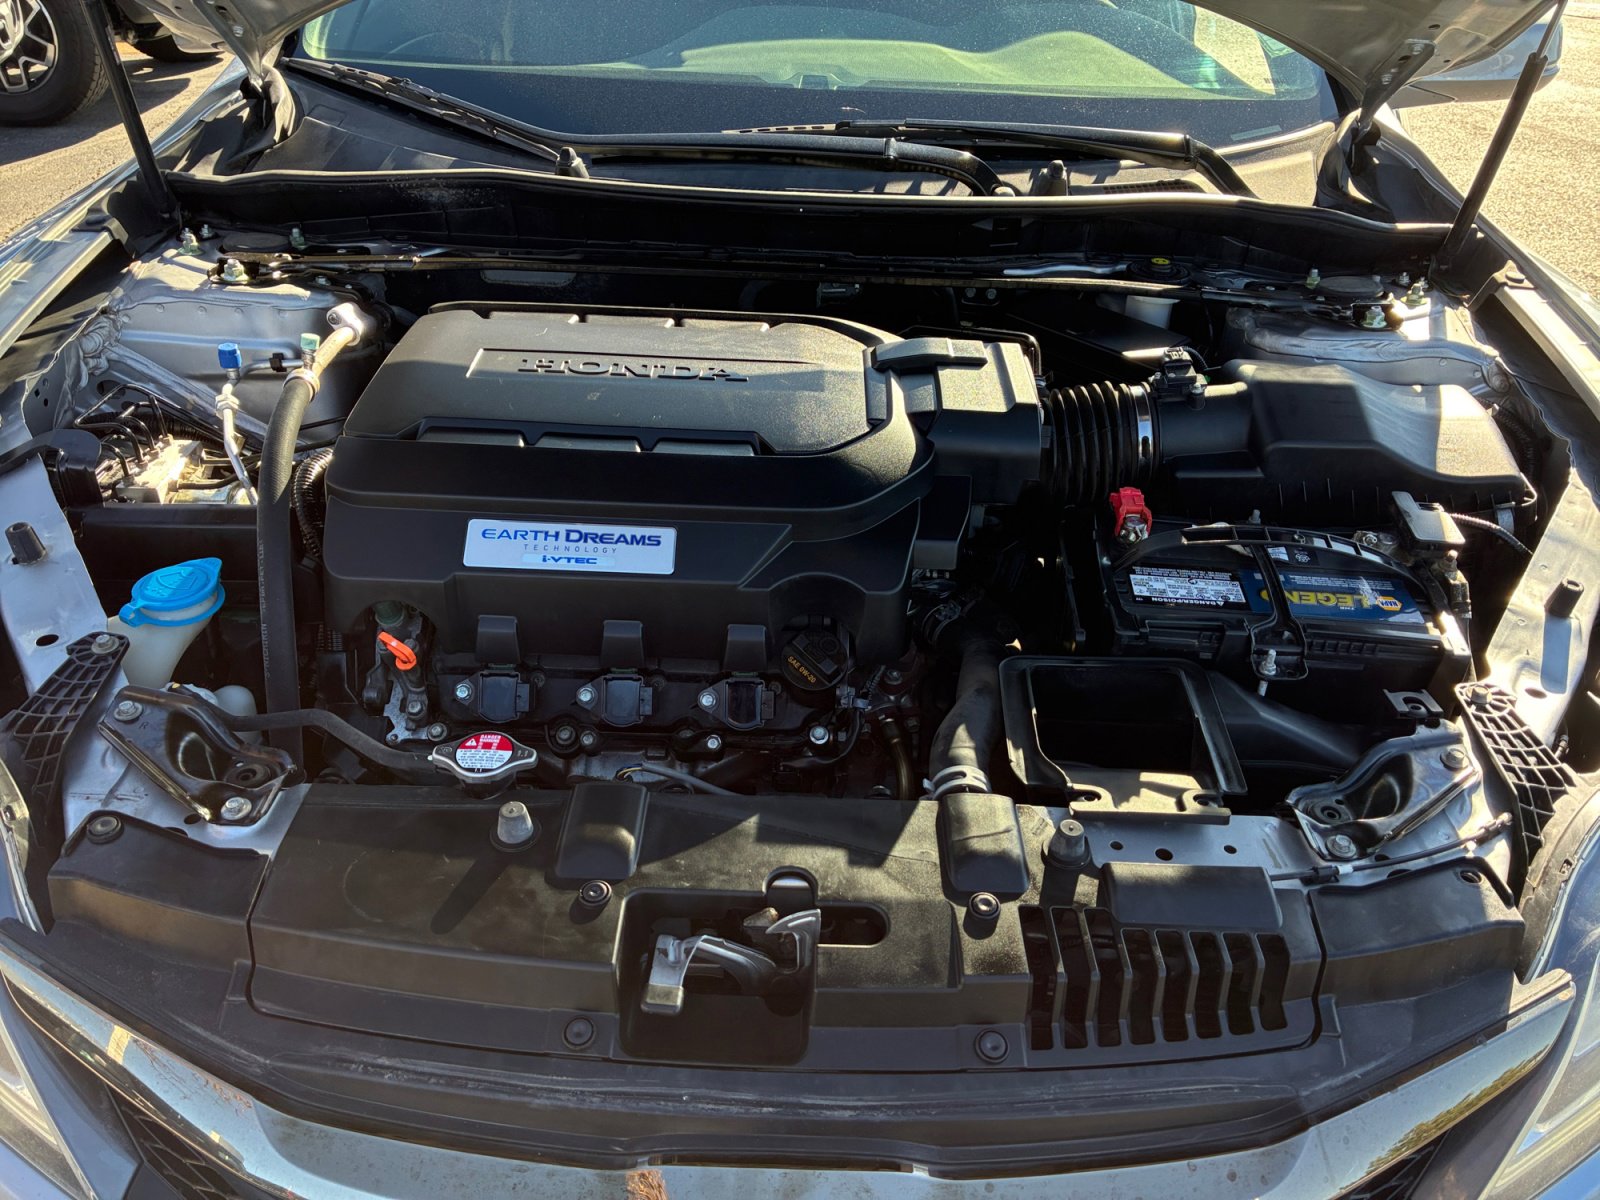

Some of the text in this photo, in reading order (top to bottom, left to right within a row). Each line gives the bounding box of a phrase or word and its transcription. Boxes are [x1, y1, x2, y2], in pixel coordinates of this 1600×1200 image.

[517, 358, 749, 382] HONDA
[481, 528, 661, 547] EARTH DREAMS
[523, 543, 618, 554] TECHNOLOGY
[541, 555, 598, 565] i-VTEC
[1378, 599, 1399, 608] NAPA
[787, 656, 817, 683] SAE 0W-20
